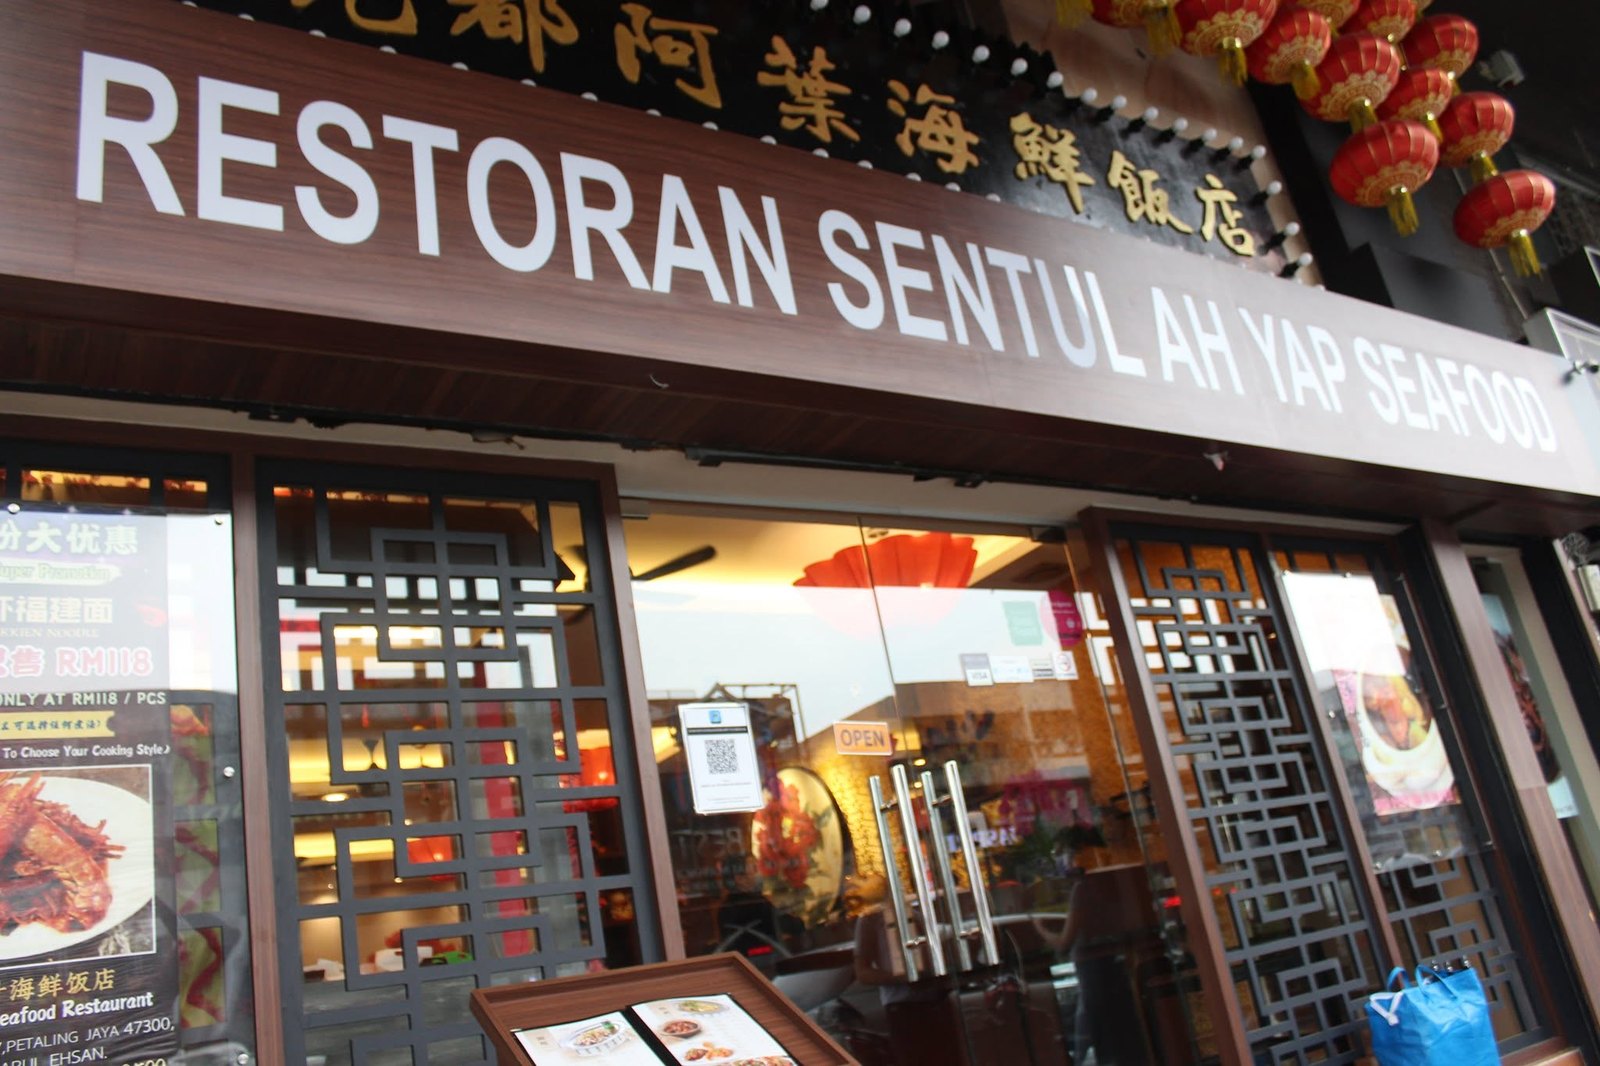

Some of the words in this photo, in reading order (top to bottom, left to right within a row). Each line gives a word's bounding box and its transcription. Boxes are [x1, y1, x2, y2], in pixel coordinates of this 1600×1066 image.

[76, 50, 798, 315] RESTORAN
[818, 209, 1147, 377] SENTUL
[1151, 286, 1245, 395] AH
[1239, 307, 1346, 413] YAP
[1353, 336, 1558, 452] SEAFOOD
[0, 562, 33, 580] uper
[56, 646, 153, 677] RM118
[0, 693, 36, 707] NLY
[43, 692, 66, 706] AT
[72, 692, 118, 706] RM118
[137, 692, 167, 705] PCS
[839, 728, 886, 749] OPEN
[2, 747, 18, 759] To
[20, 747, 60, 758] Choose
[63, 745, 90, 757] Your
[92, 744, 134, 759] Cooking
[0, 968, 117, 1001] 海鲜饭店
[62, 992, 154, 1018] Restaurant
[85, 1026, 120, 1042] JAYA
[124, 1017, 175, 1035] 47300,
[50, 1046, 108, 1066] EHSAN.
